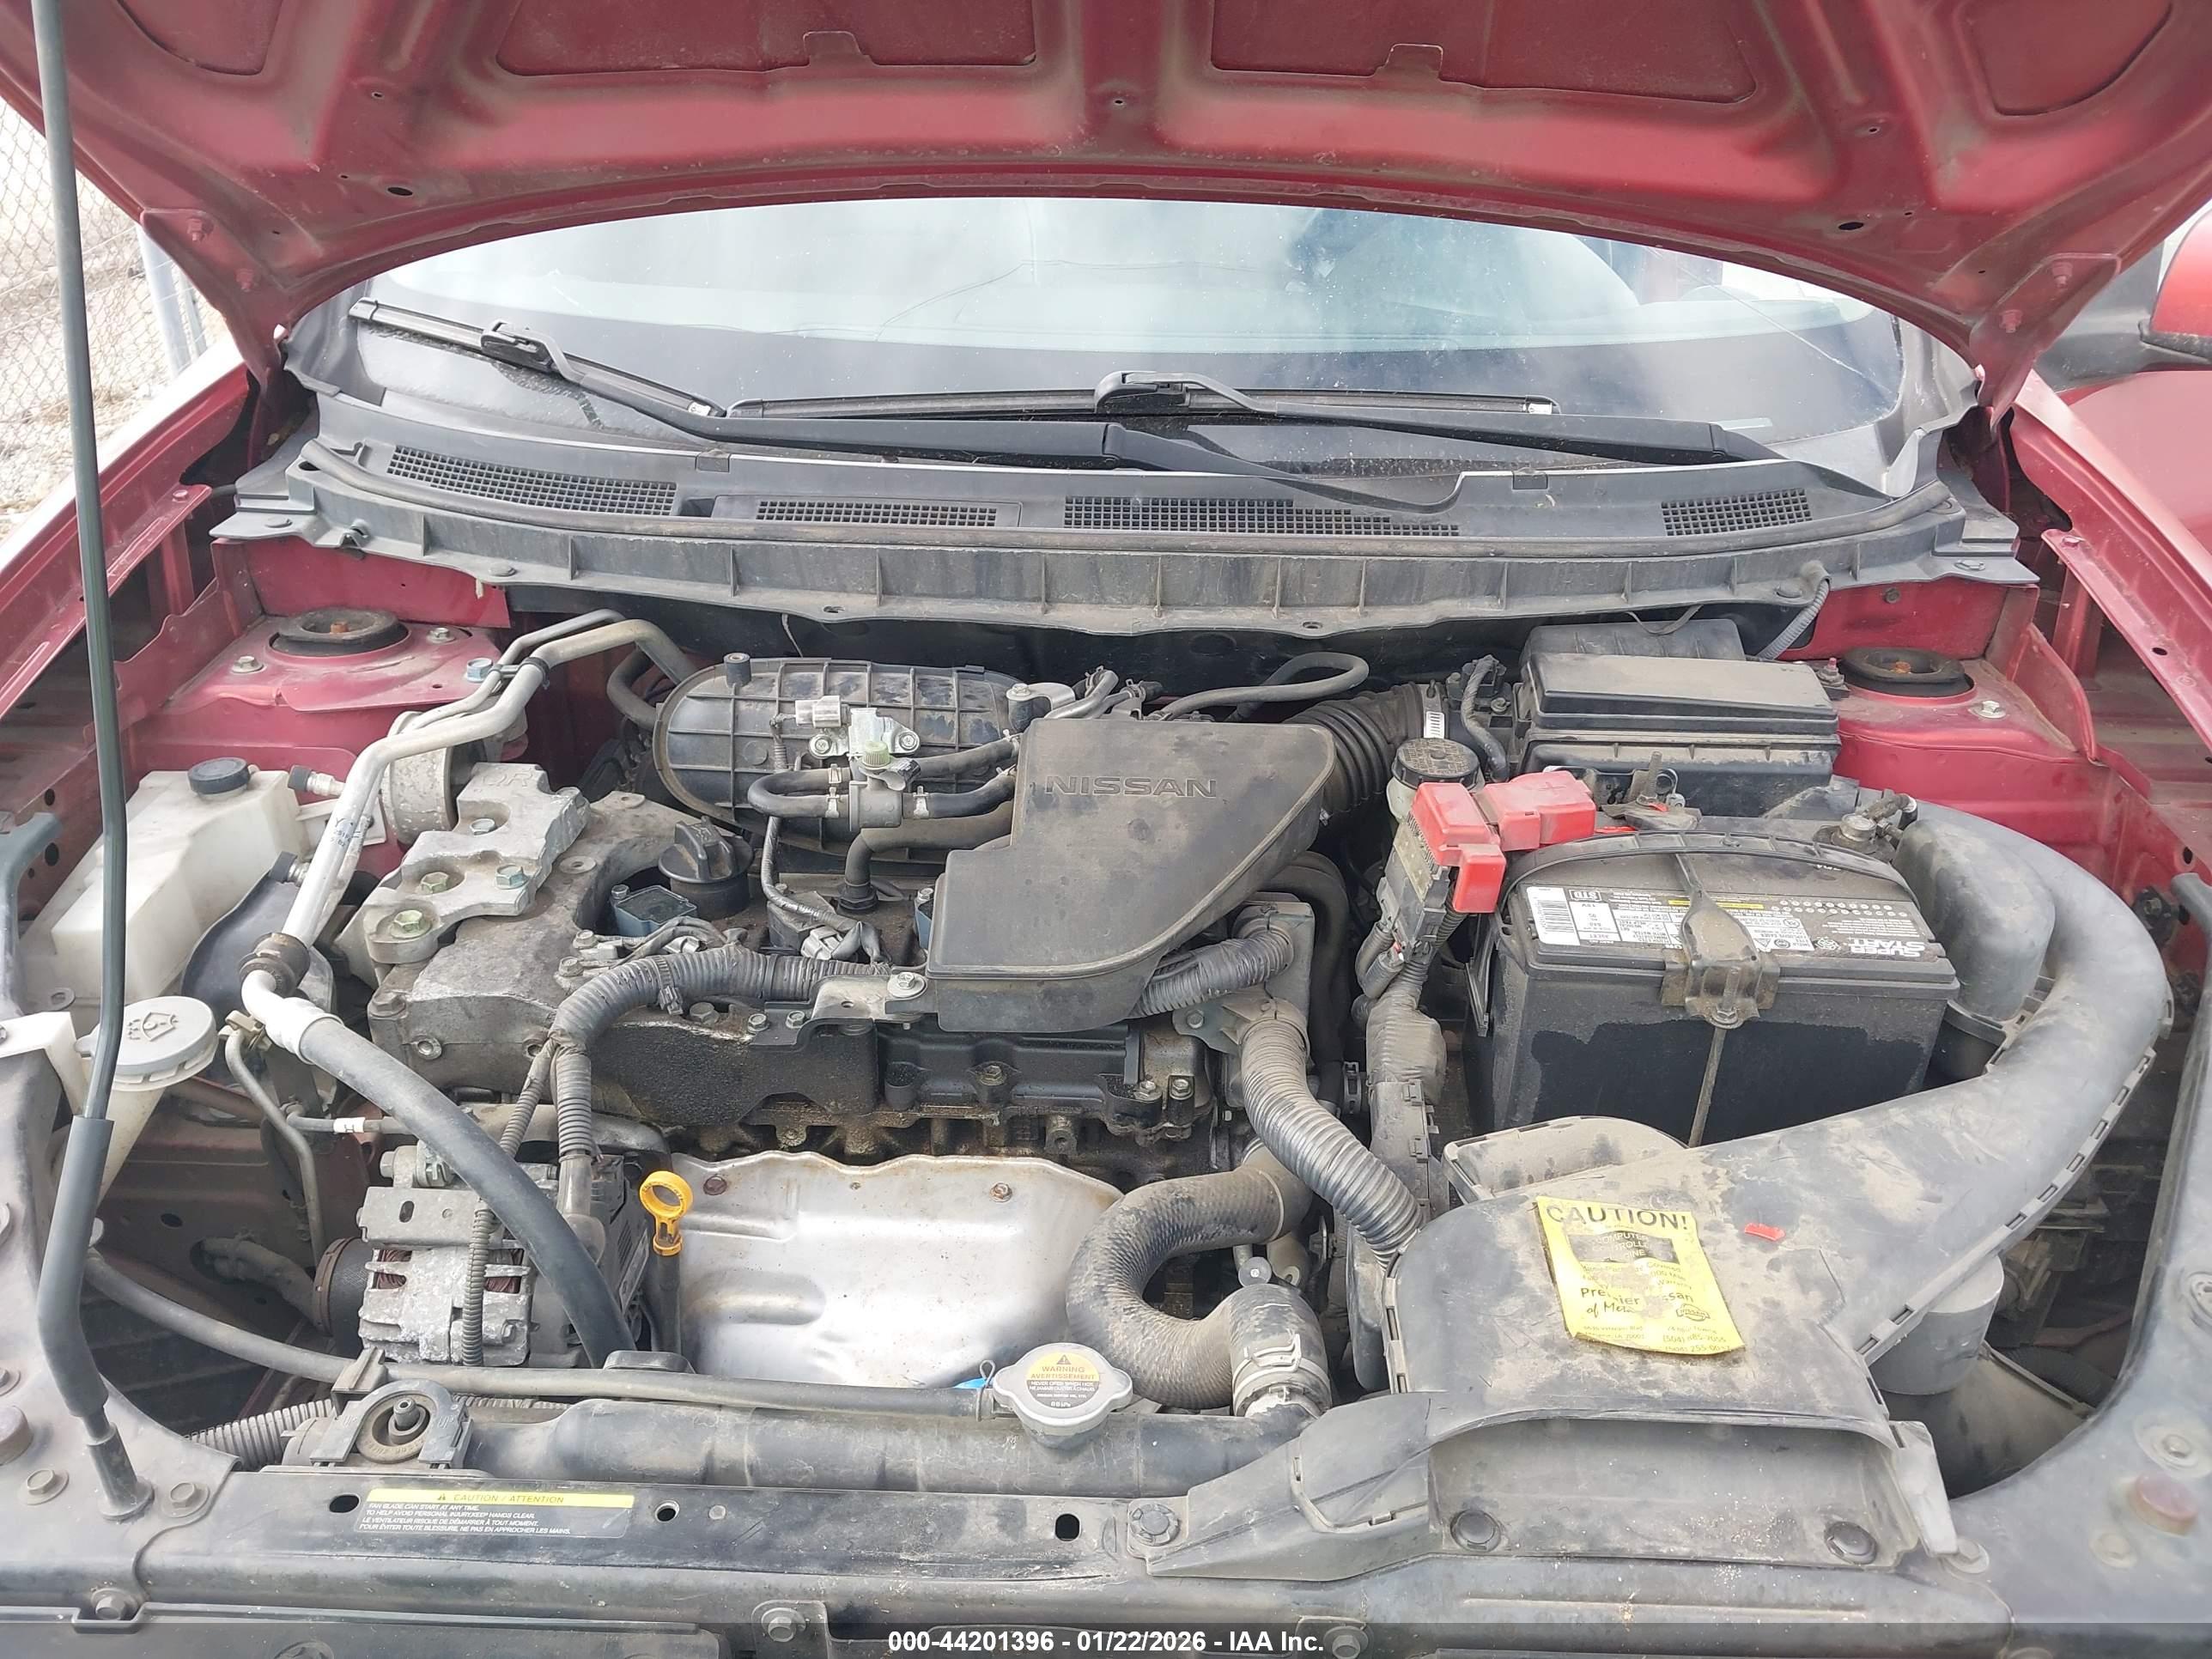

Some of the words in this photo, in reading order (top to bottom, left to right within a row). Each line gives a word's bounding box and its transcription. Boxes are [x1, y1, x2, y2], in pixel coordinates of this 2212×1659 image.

[1044, 774, 1218, 798] NISSAN
[1848, 939, 1926, 951] START
[1850, 946, 1921, 957] SUPER
[1545, 1205, 1688, 1231] CAUTION!
[453, 1493, 499, 1502] CAUTION
[508, 1495, 565, 1504] ATTENTION
[449, 1517, 485, 1526] DÉMARRER
